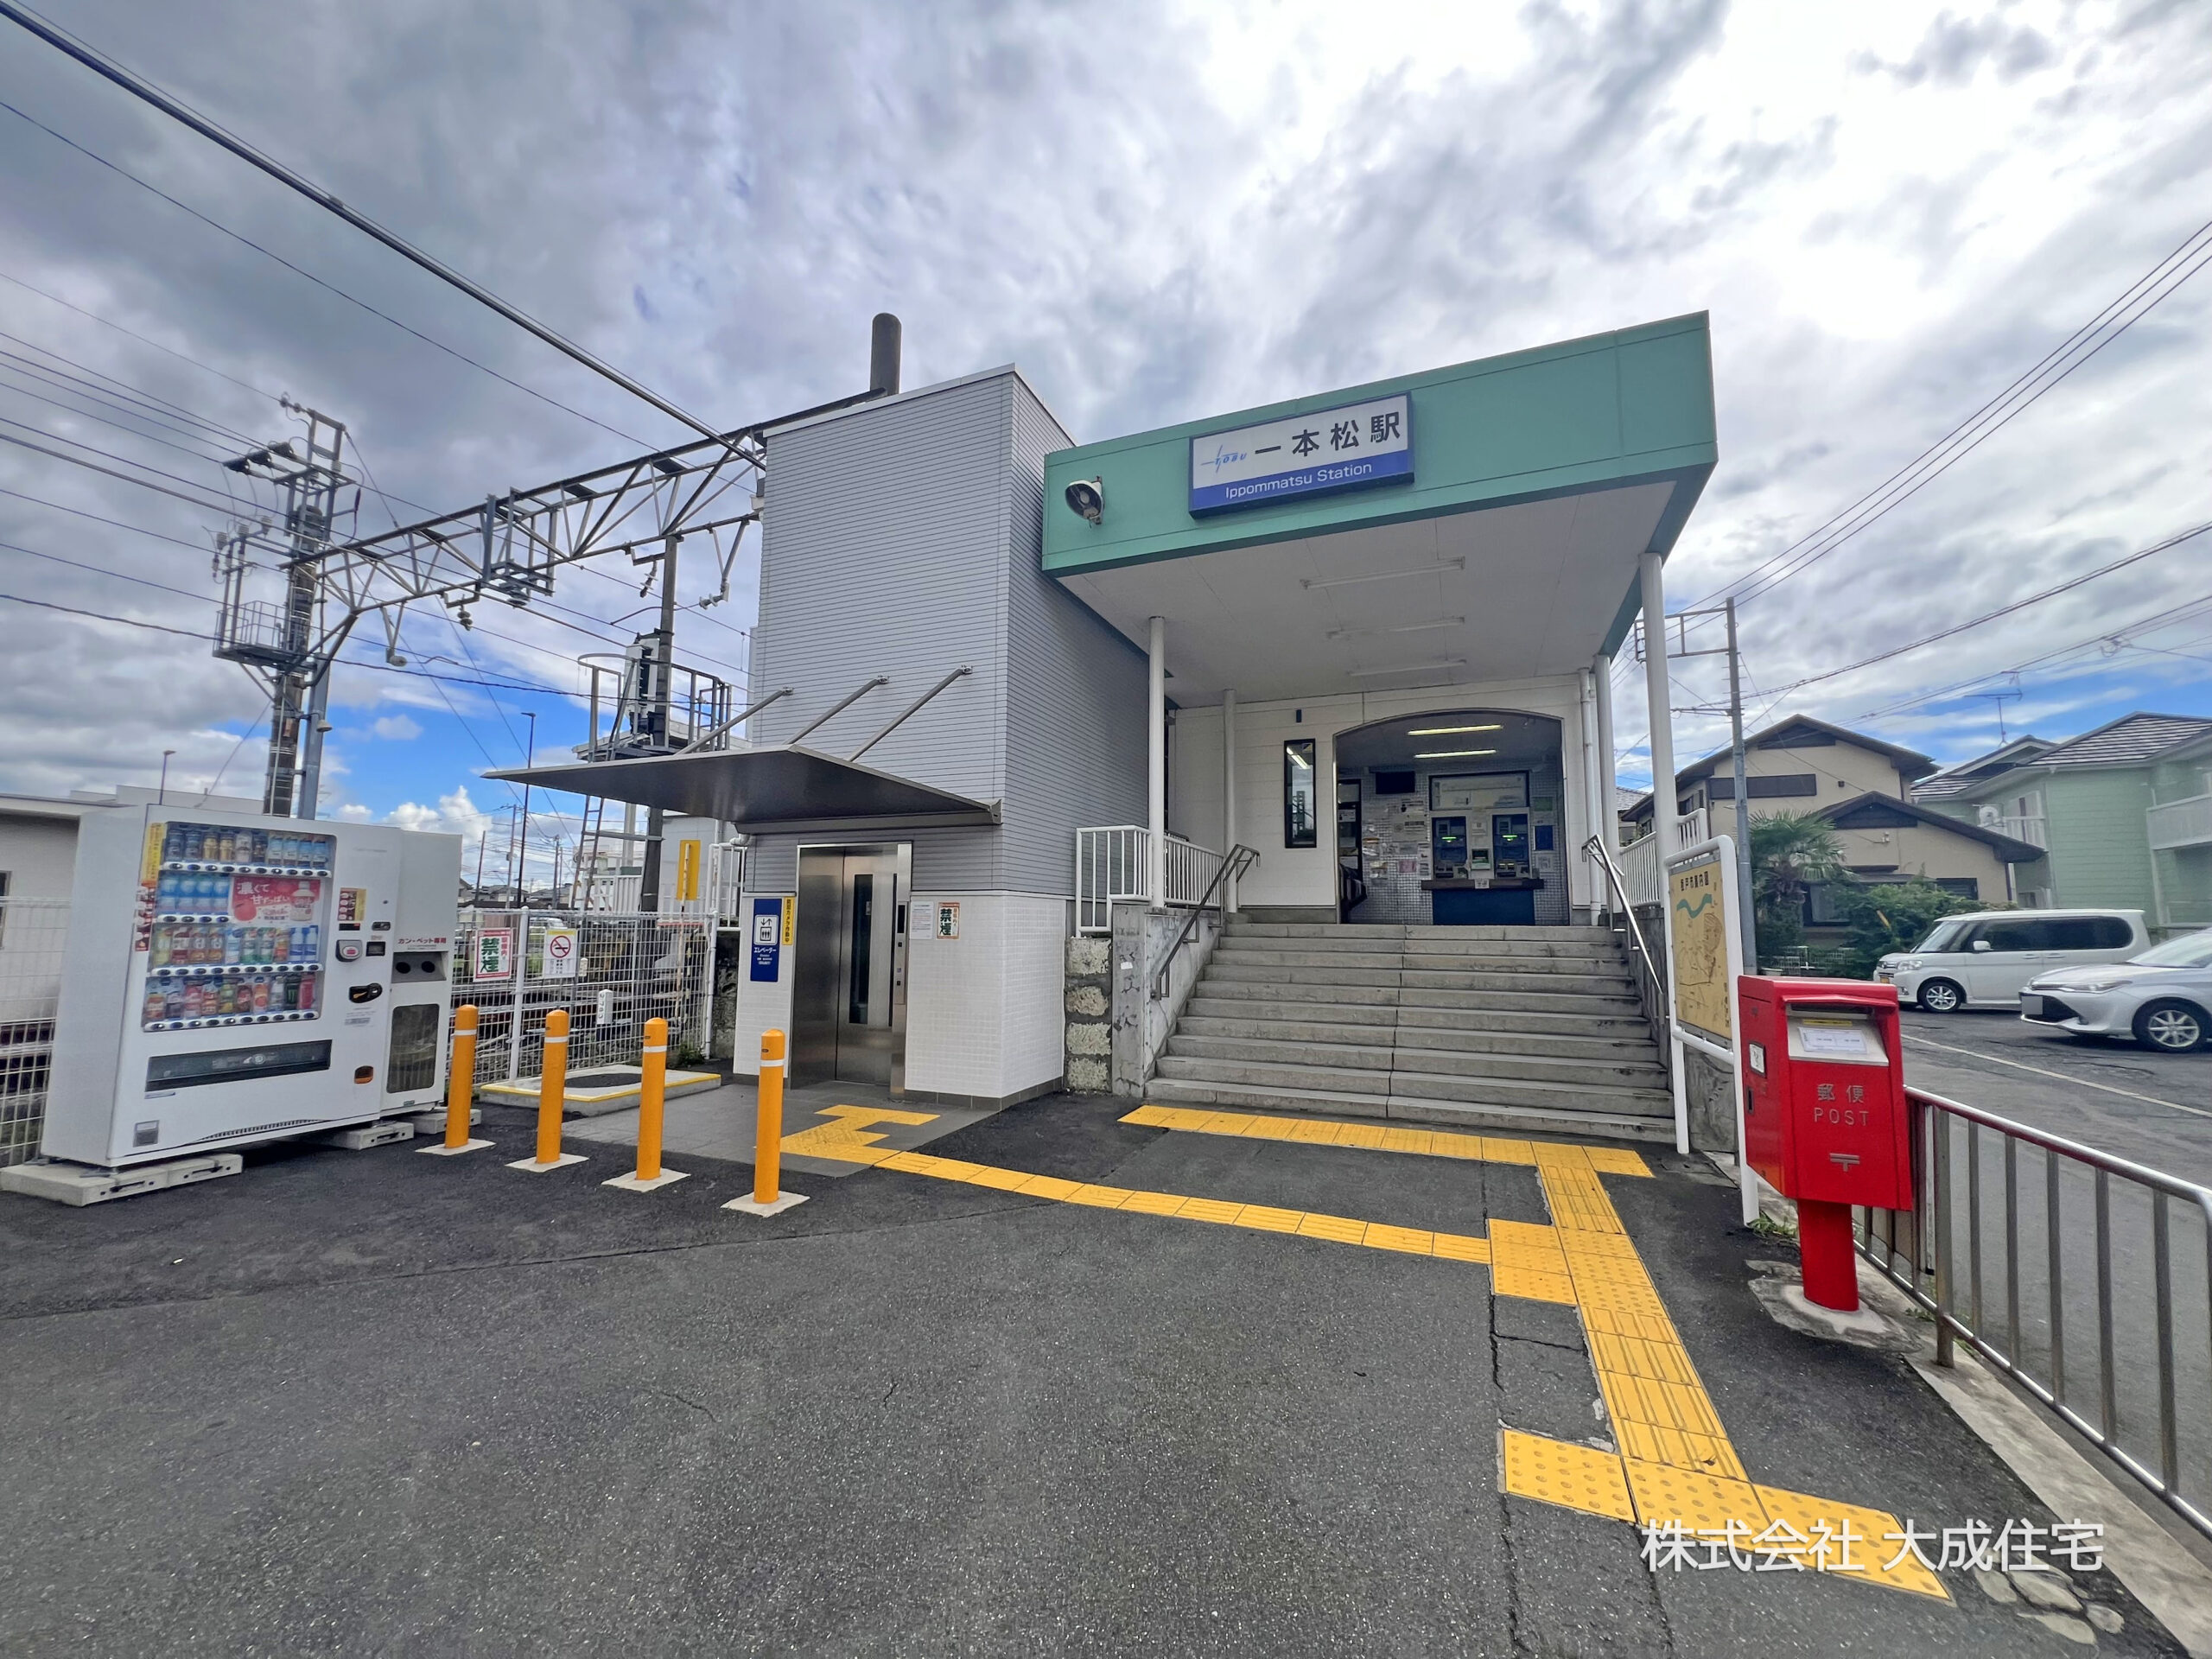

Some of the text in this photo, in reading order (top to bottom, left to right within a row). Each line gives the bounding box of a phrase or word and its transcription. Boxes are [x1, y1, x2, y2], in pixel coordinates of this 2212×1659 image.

[1255, 411, 1401, 457] 一本松駅
[1225, 463, 1372, 499] Ippommatsu Station
[939, 908, 952, 936] 禁煙
[480, 938, 500, 973] 禁煙
[1817, 1083, 1865, 1103] 郵便
[1815, 1107, 1869, 1126] POST
